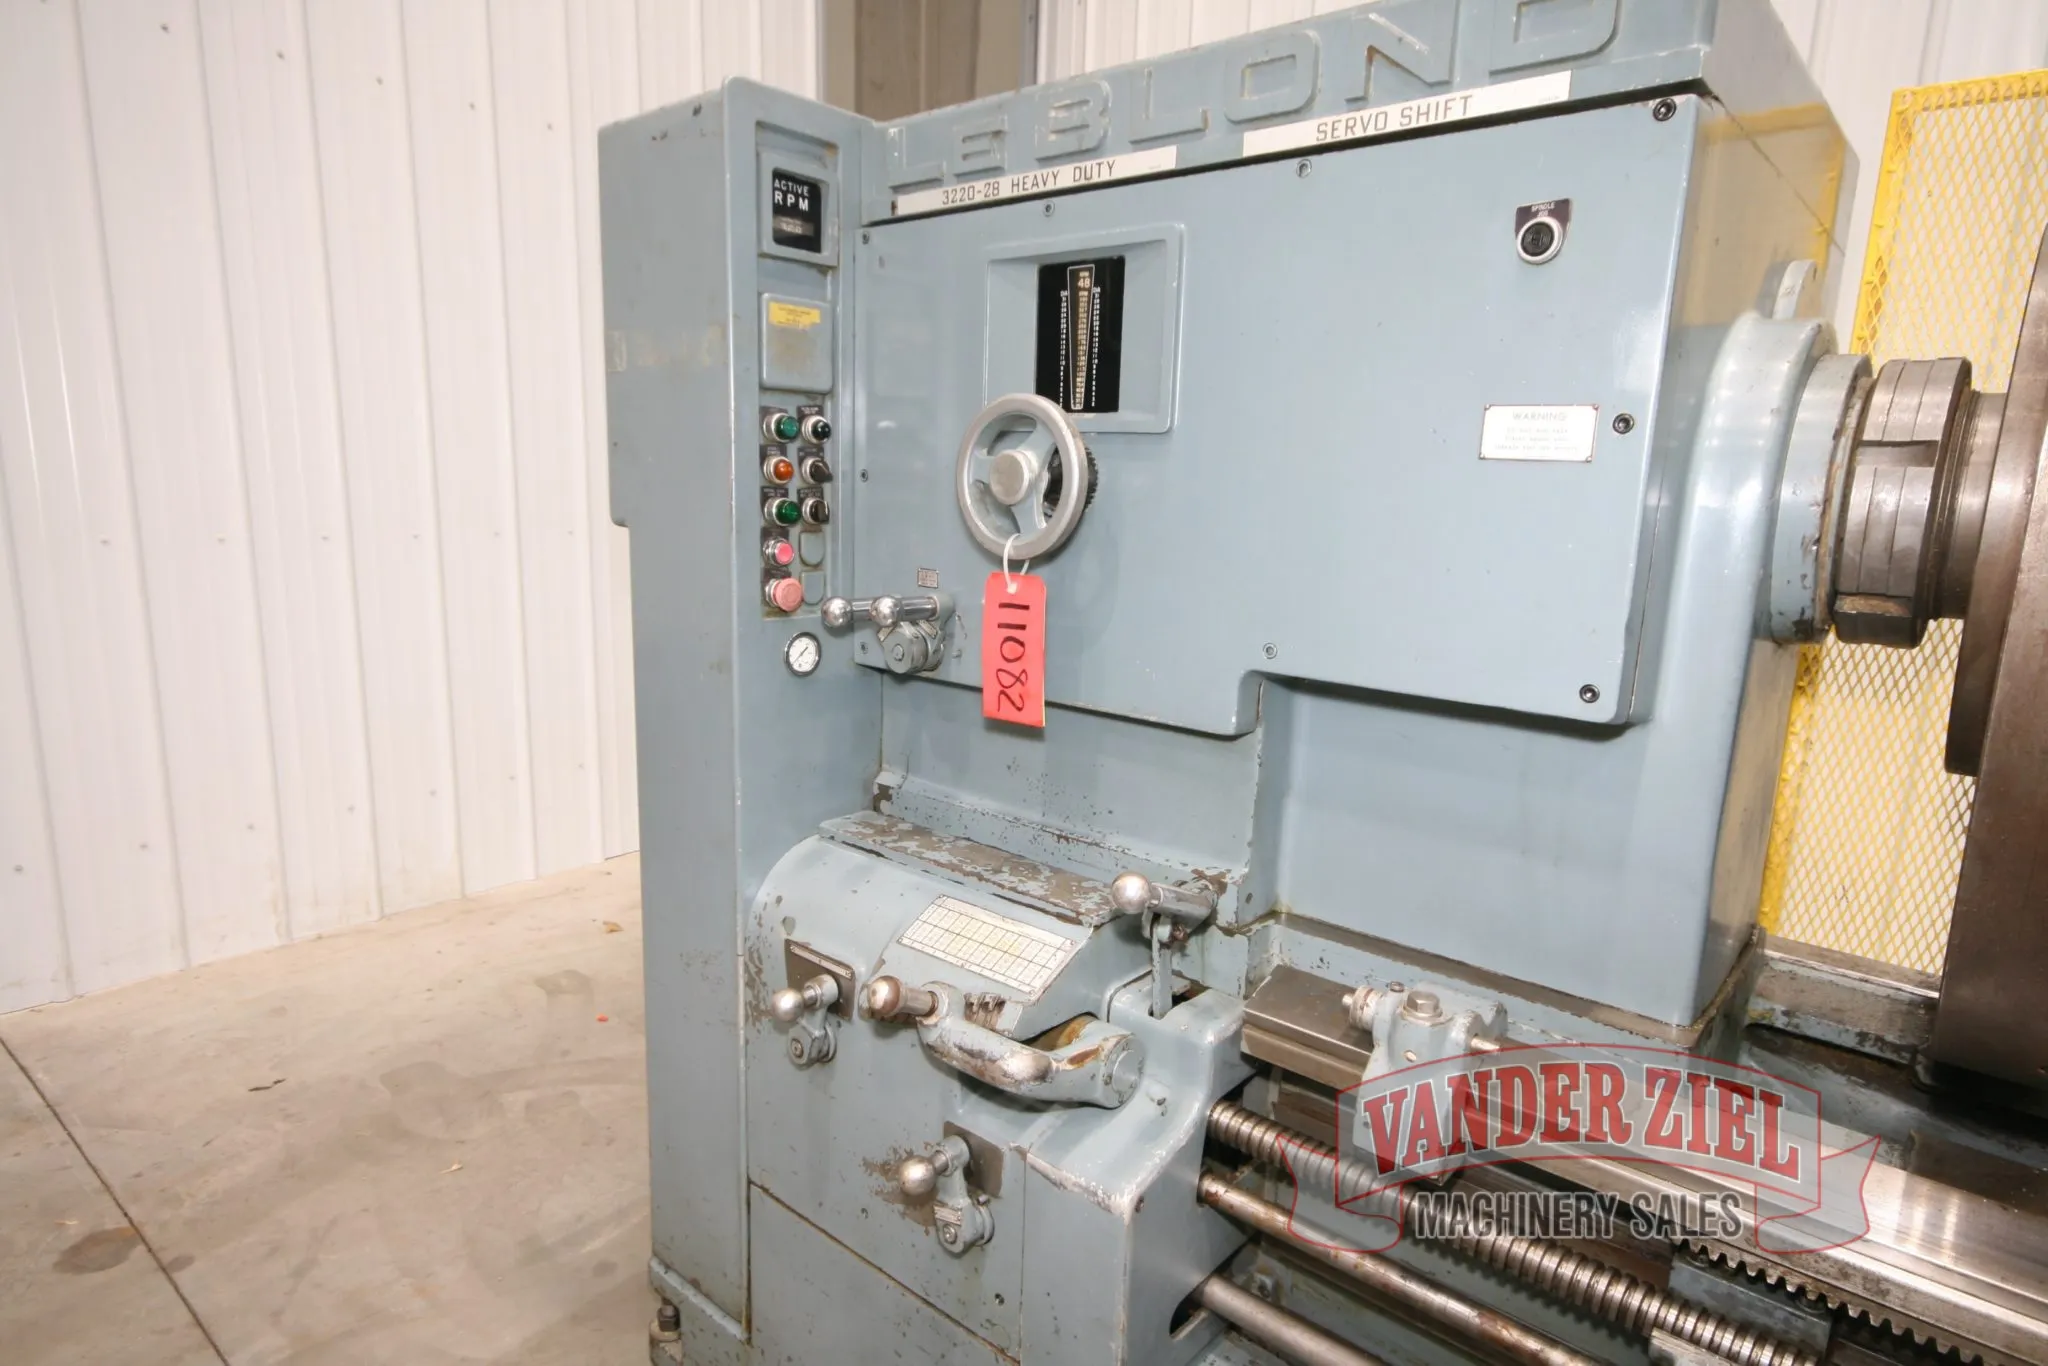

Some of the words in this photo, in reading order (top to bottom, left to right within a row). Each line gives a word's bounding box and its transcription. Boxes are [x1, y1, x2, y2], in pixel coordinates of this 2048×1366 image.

[886, 0, 1621, 191] LEBLOND
[1315, 110, 1389, 142] SERVO
[1399, 94, 1474, 128] SHIFT
[774, 178, 809, 197] ACTIVE
[1011, 169, 1061, 194] HEAVY
[1072, 159, 1116, 183] DUTY
[774, 190, 809, 212] RPM
[1531, 202, 1555, 213] SPINDLE
[1512, 410, 1568, 422] WARNING
[995, 602, 1031, 713] 11082
